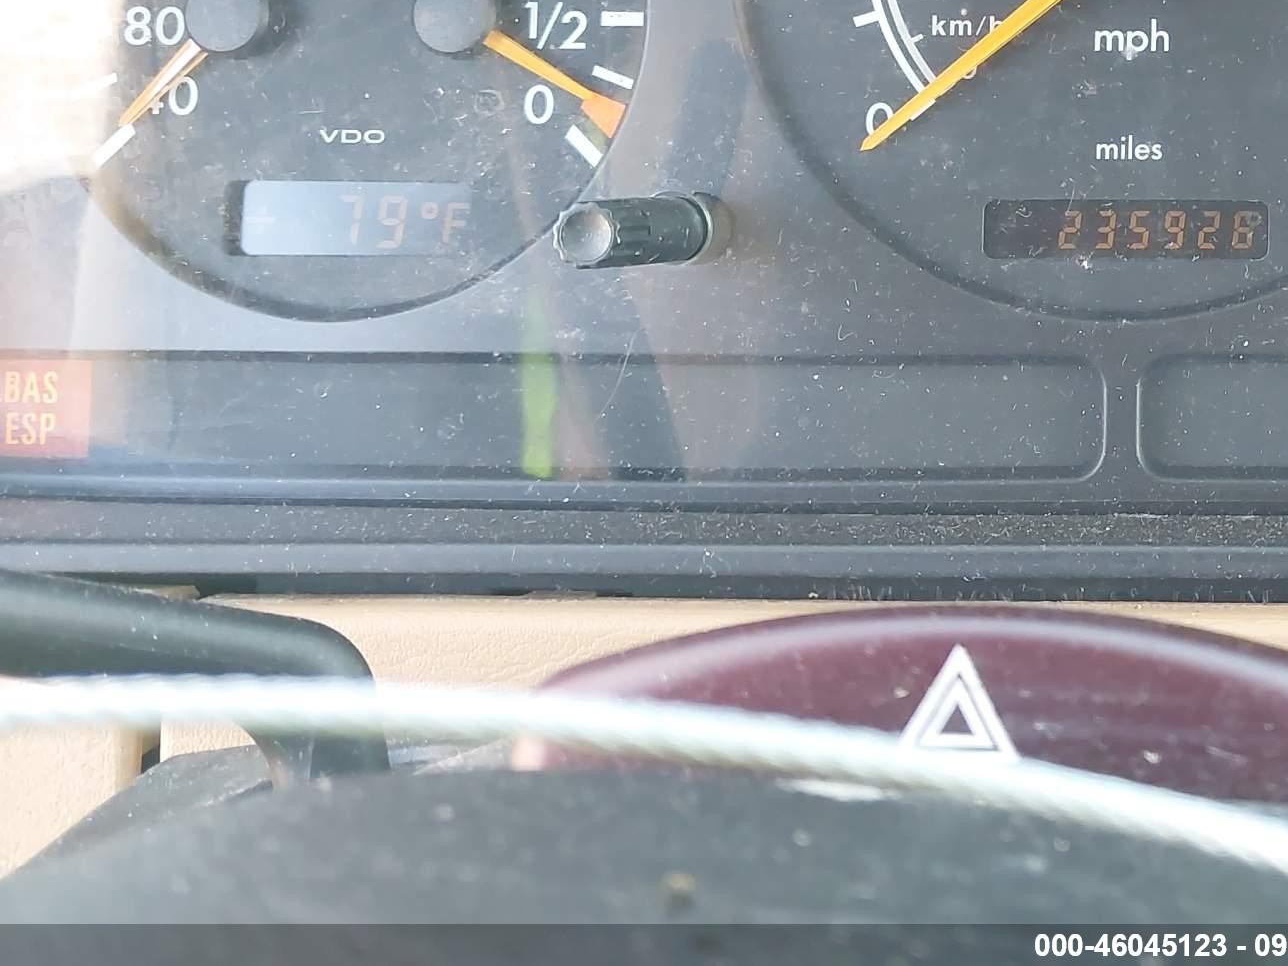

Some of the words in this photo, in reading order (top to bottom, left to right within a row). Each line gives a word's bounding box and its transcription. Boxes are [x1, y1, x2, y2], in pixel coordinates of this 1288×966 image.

[123, 5, 185, 46] 80
[524, 1, 588, 50] 1/2
[1094, 18, 1170, 56] mph
[523, 84, 555, 124] 0
[319, 128, 385, 144] VDO
[1096, 134, 1163, 160] miles
[4, 370, 58, 404] BAS
[5, 412, 57, 445] ESP
